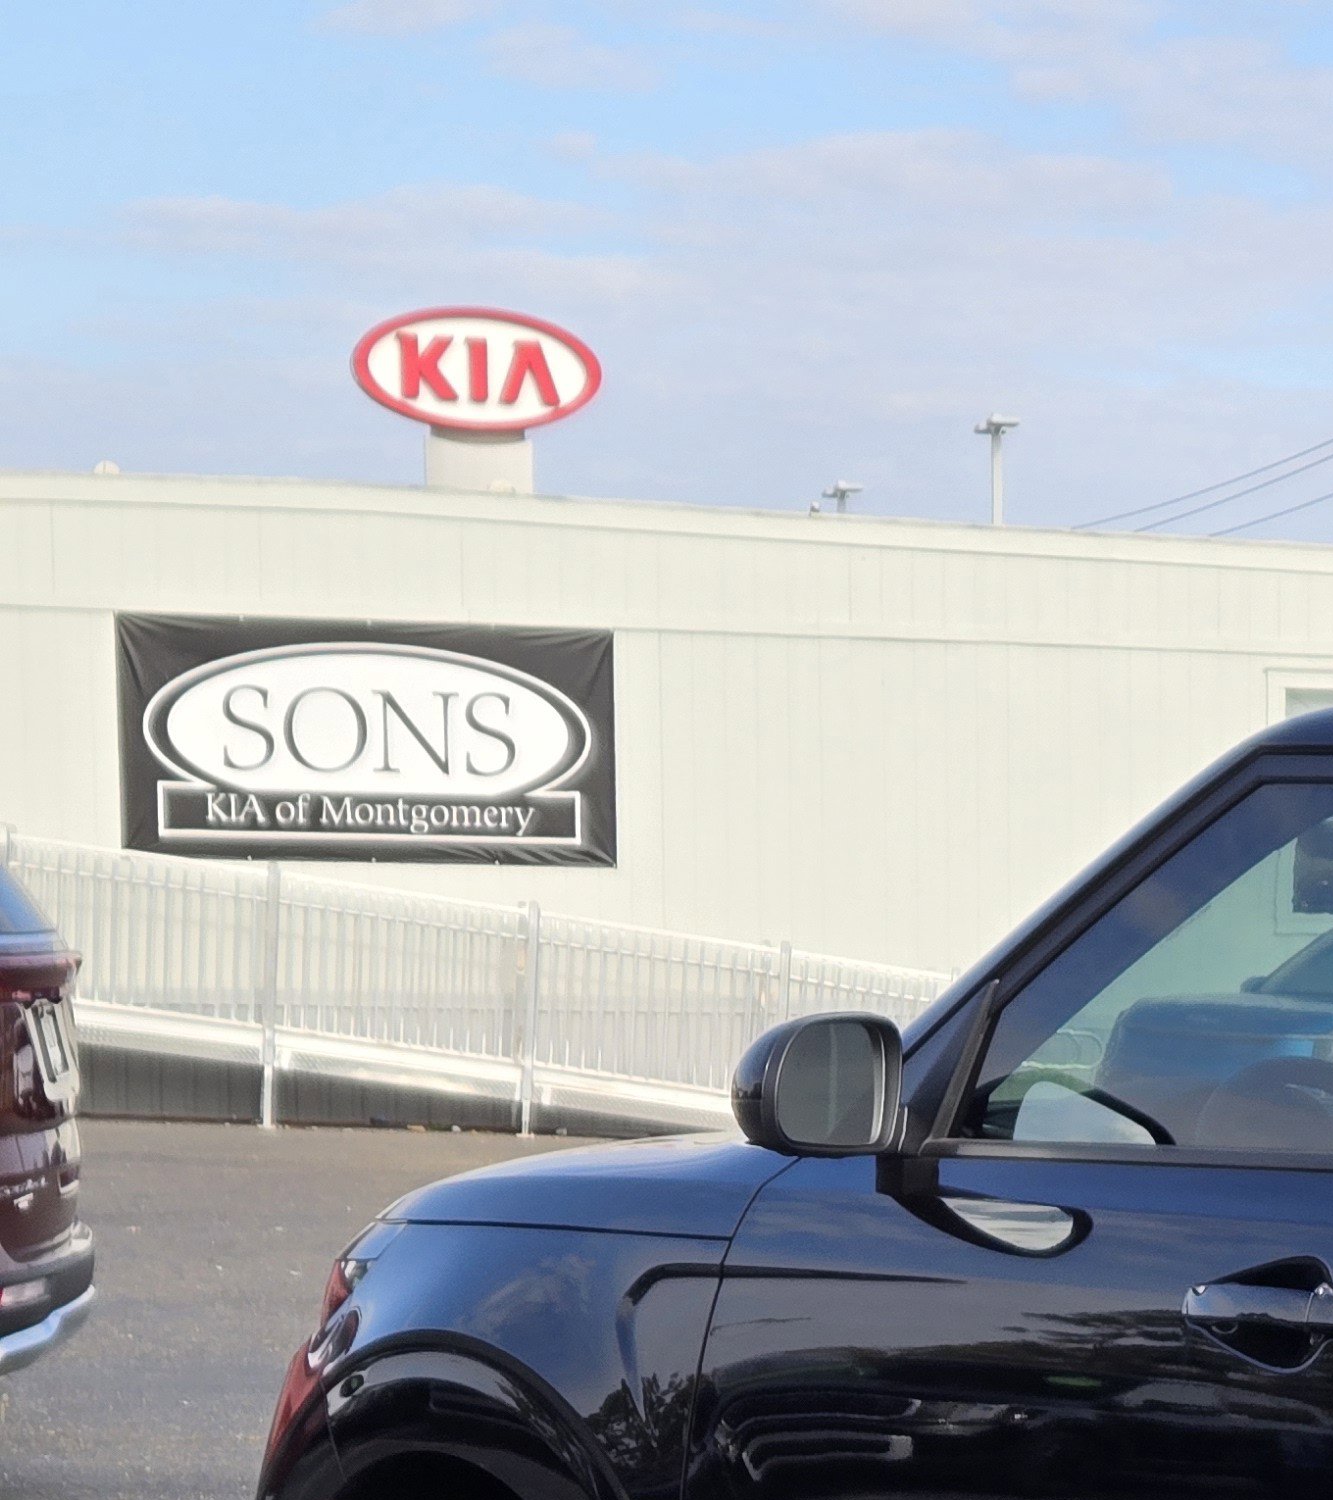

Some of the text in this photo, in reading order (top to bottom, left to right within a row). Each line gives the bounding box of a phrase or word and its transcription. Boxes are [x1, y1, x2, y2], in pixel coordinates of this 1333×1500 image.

[395, 330, 561, 408] KIA
[221, 683, 517, 778] SONS
[205, 792, 536, 836] KIA of Montgomery
